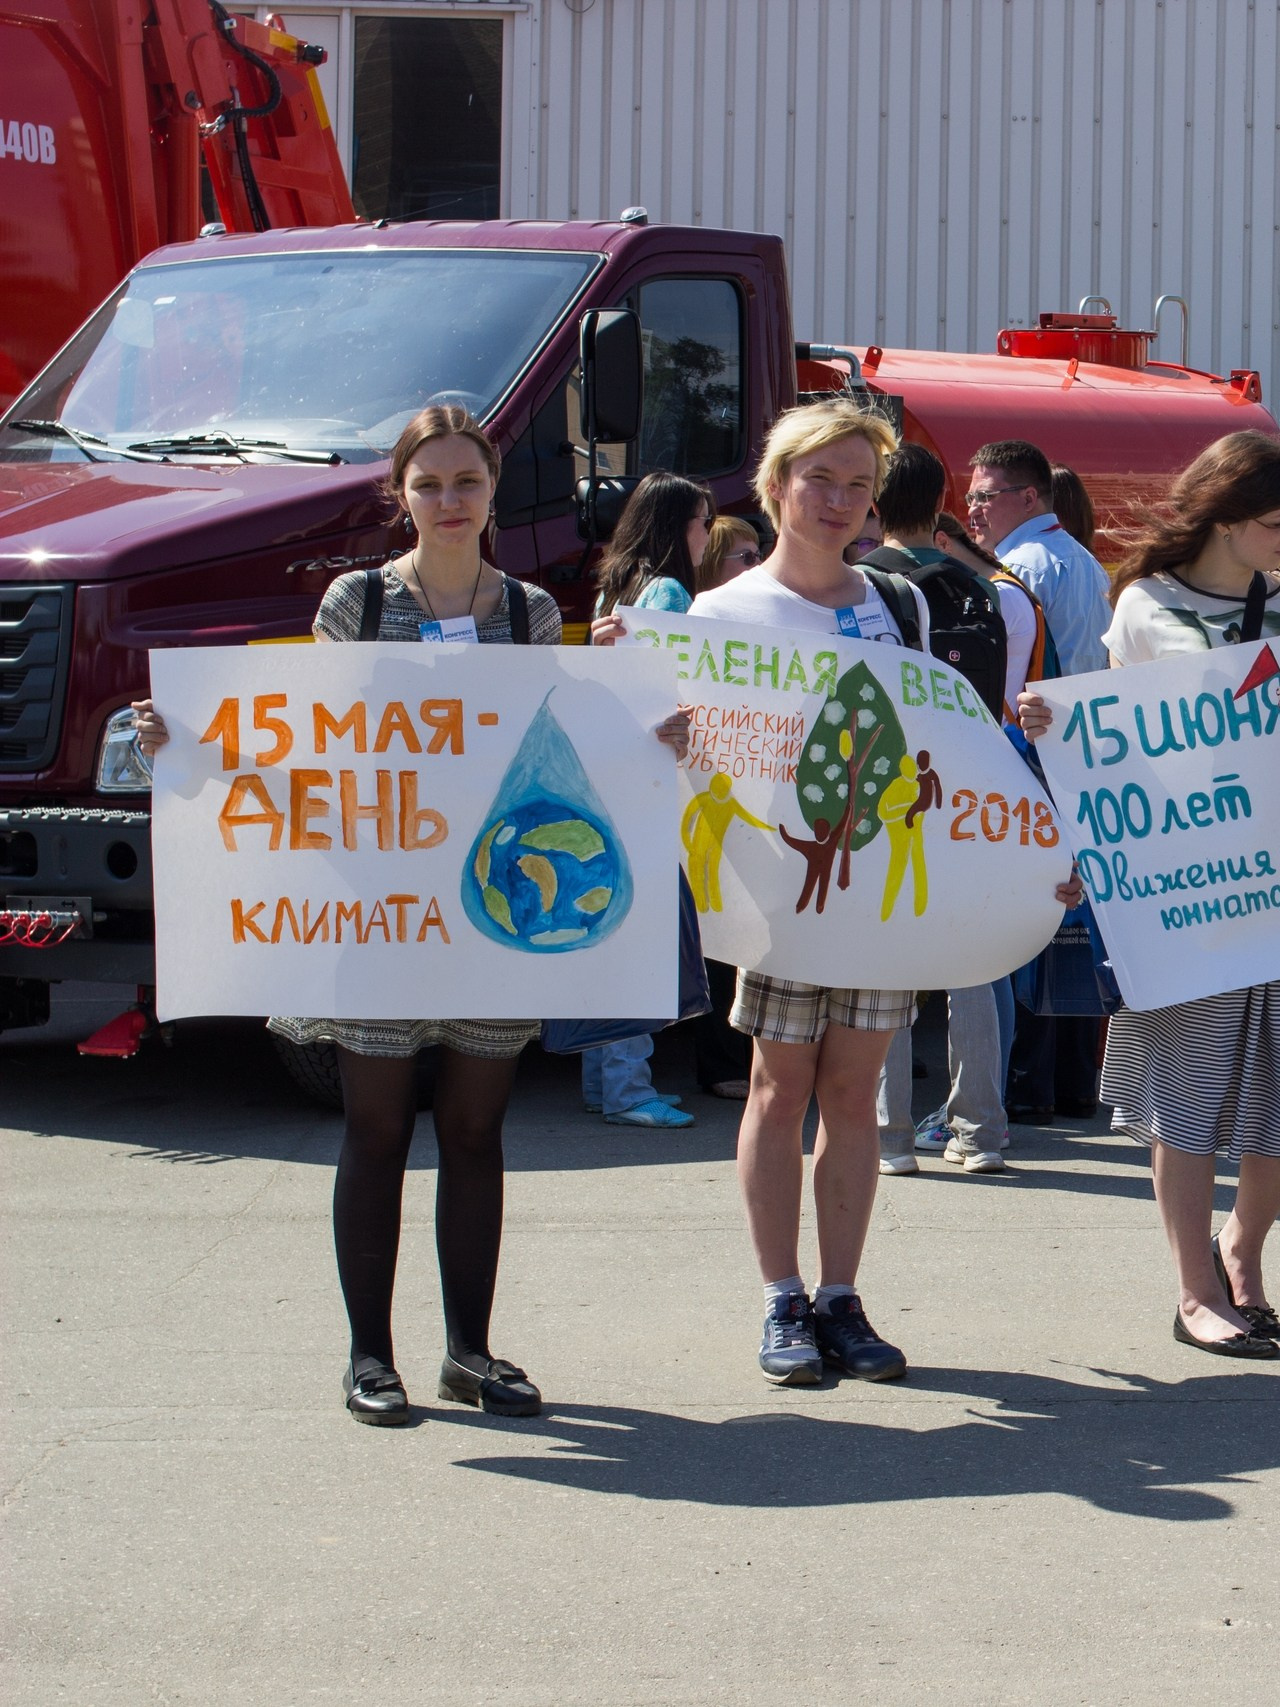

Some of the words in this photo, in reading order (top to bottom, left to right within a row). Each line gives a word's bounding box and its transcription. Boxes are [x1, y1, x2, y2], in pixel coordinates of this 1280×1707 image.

[199, 693, 294, 771] 15
[688, 729, 803, 760] ГИЧЕСКИЙ
[1062, 695, 1129, 769] 15
[677, 751, 799, 785] УББОТНИК
[218, 769, 449, 852] ДЕНЬ
[950, 789, 1060, 848] 2018
[1077, 782, 1152, 846] 100
[1161, 773, 1252, 834] лет
[1077, 848, 1276, 904] Движения
[231, 894, 451, 944] КЛИМАТА
